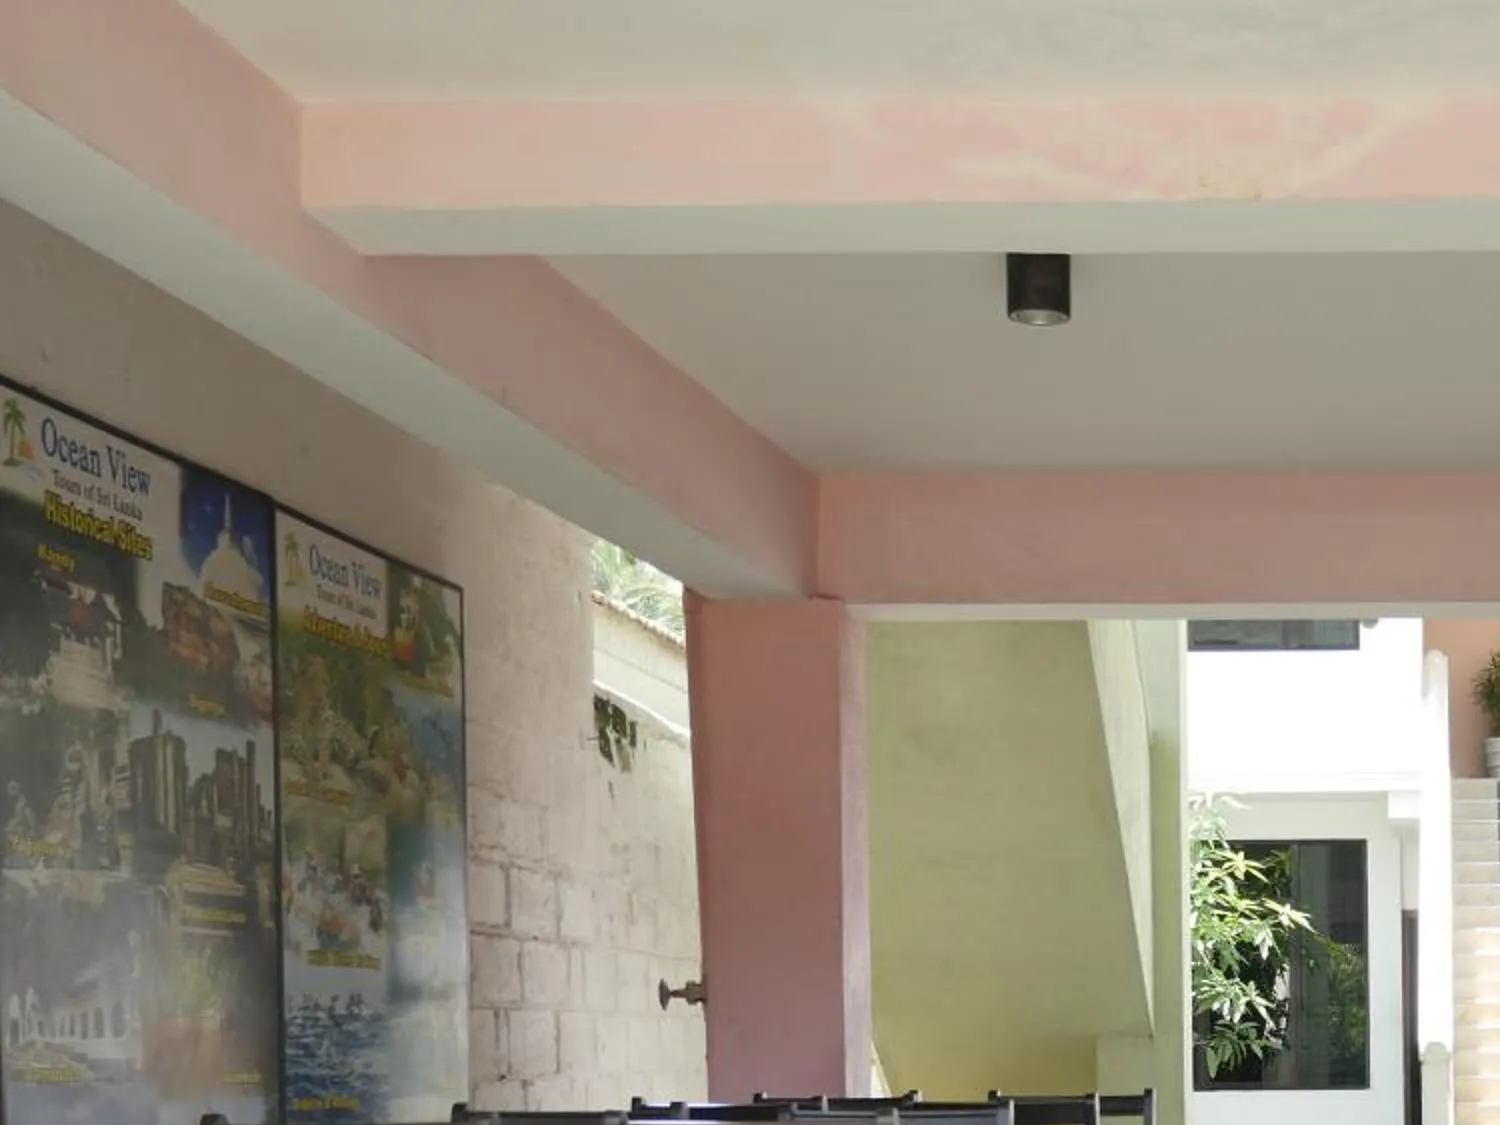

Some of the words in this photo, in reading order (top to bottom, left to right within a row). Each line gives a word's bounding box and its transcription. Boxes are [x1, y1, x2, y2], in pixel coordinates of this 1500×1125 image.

[41, 416, 102, 478] Ocean
[106, 445, 151, 497] View
[43, 489, 117, 547] Historical
[309, 544, 349, 587] Ocean
[352, 561, 382, 600] View
